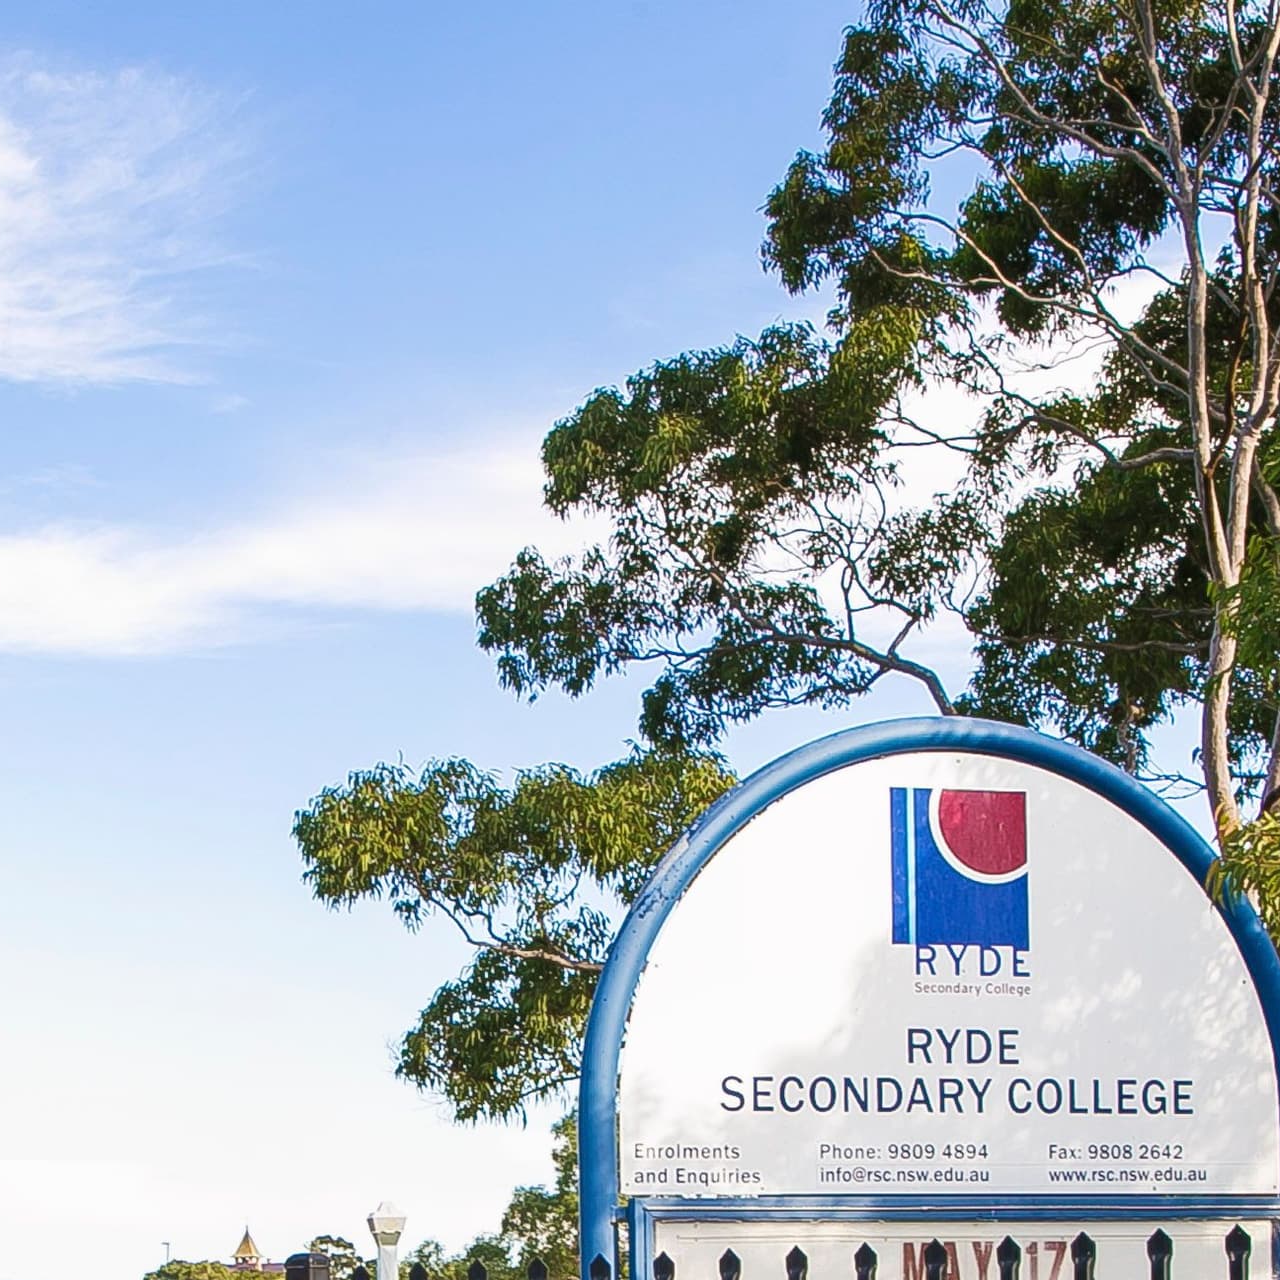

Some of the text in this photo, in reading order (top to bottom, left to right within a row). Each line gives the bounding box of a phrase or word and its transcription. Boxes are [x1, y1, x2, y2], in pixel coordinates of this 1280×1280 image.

[915, 945, 1031, 977] RYDE
[915, 982, 1031, 997] Secondary College
[907, 1029, 1020, 1064] RYDE
[720, 1076, 1194, 1115] SECONDARY COLLEGE
[634, 1144, 740, 1160] Enrolments
[820, 1144, 989, 1160] Phone: 9809 4894
[1048, 1144, 1183, 1160] Fax: 9808 2642
[634, 1169, 761, 1186] and Enquiries
[820, 1167, 990, 1182] info@rsc.nsw.edu.au
[1048, 1167, 1207, 1182] www.rsc.nsw.edu.au
